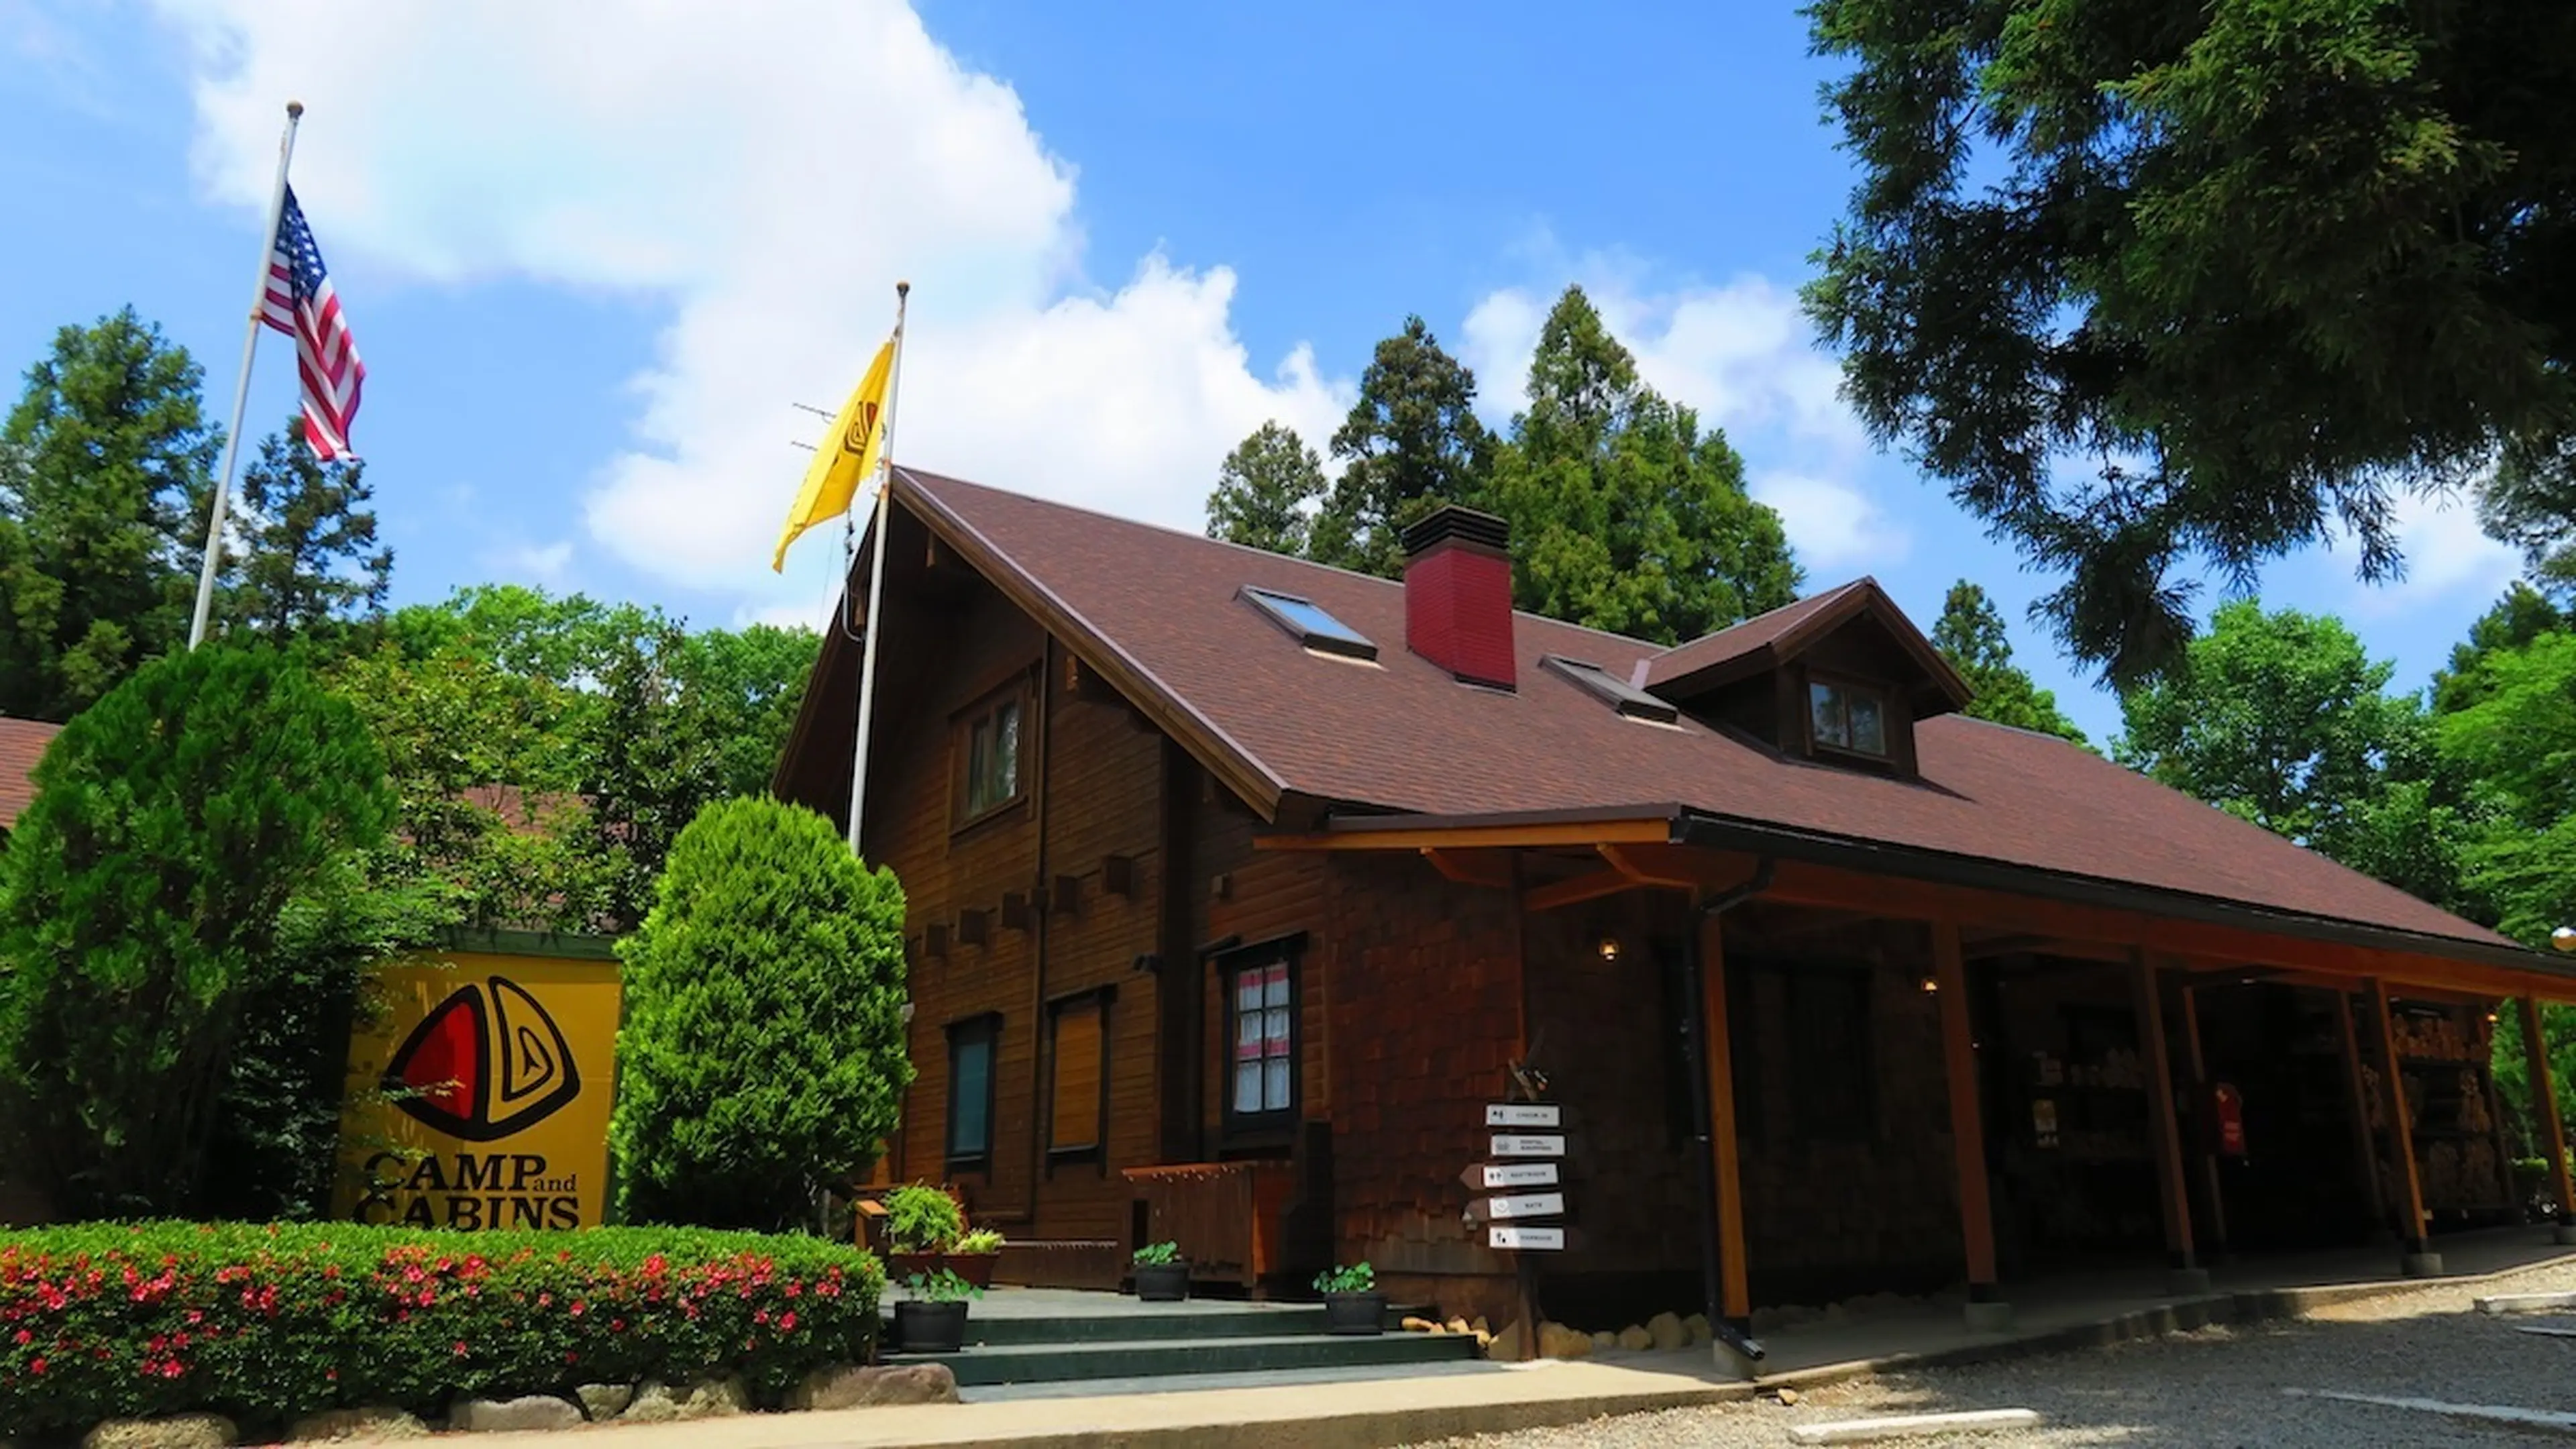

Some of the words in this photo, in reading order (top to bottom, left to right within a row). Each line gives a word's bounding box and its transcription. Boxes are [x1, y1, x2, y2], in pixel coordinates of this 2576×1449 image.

[364, 1152, 546, 1192] CAMP
[533, 1174, 576, 1192] and
[353, 1196, 580, 1232] CABINS
